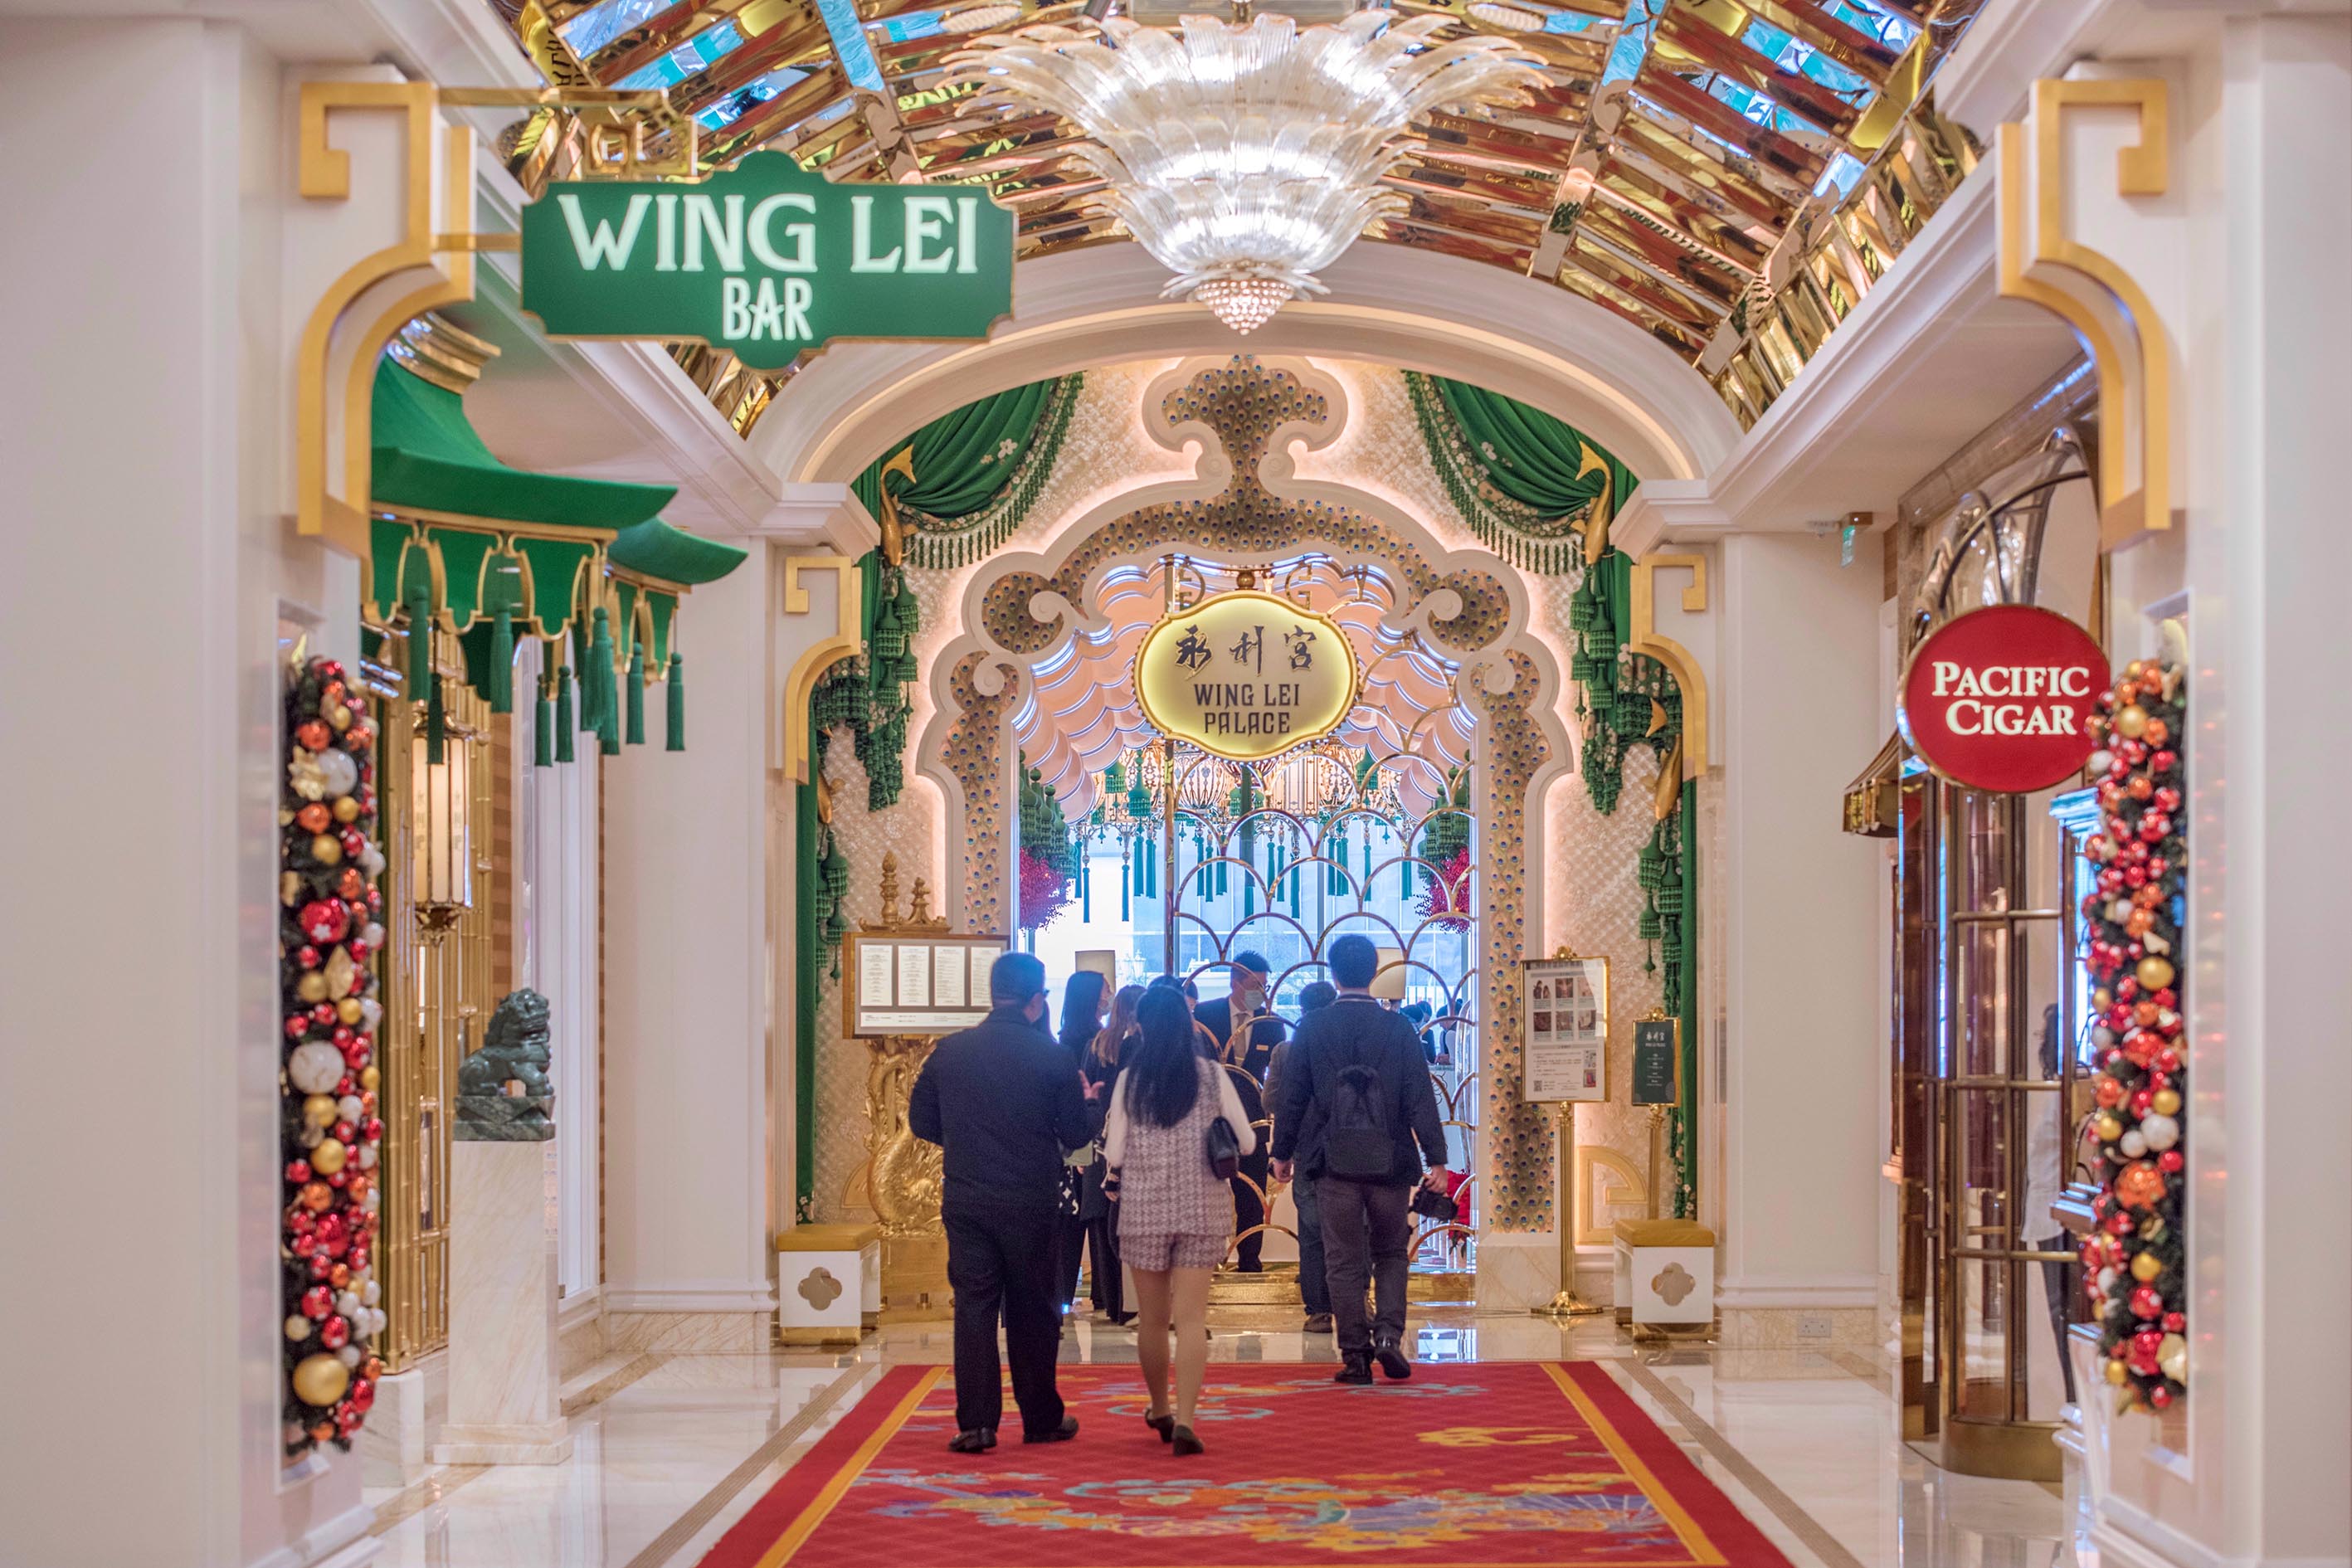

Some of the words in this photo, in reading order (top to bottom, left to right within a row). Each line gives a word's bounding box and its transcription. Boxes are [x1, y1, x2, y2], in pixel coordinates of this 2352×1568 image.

[556, 193, 819, 273] WING
[850, 195, 979, 274] LEI
[722, 277, 814, 341] BAR
[1194, 683, 1254, 709] WING
[1264, 683, 1300, 706] LEI
[1931, 660, 2090, 697] PACIFIC
[1204, 711, 1291, 737] PALACE
[1945, 699, 2078, 736] CIGAR
